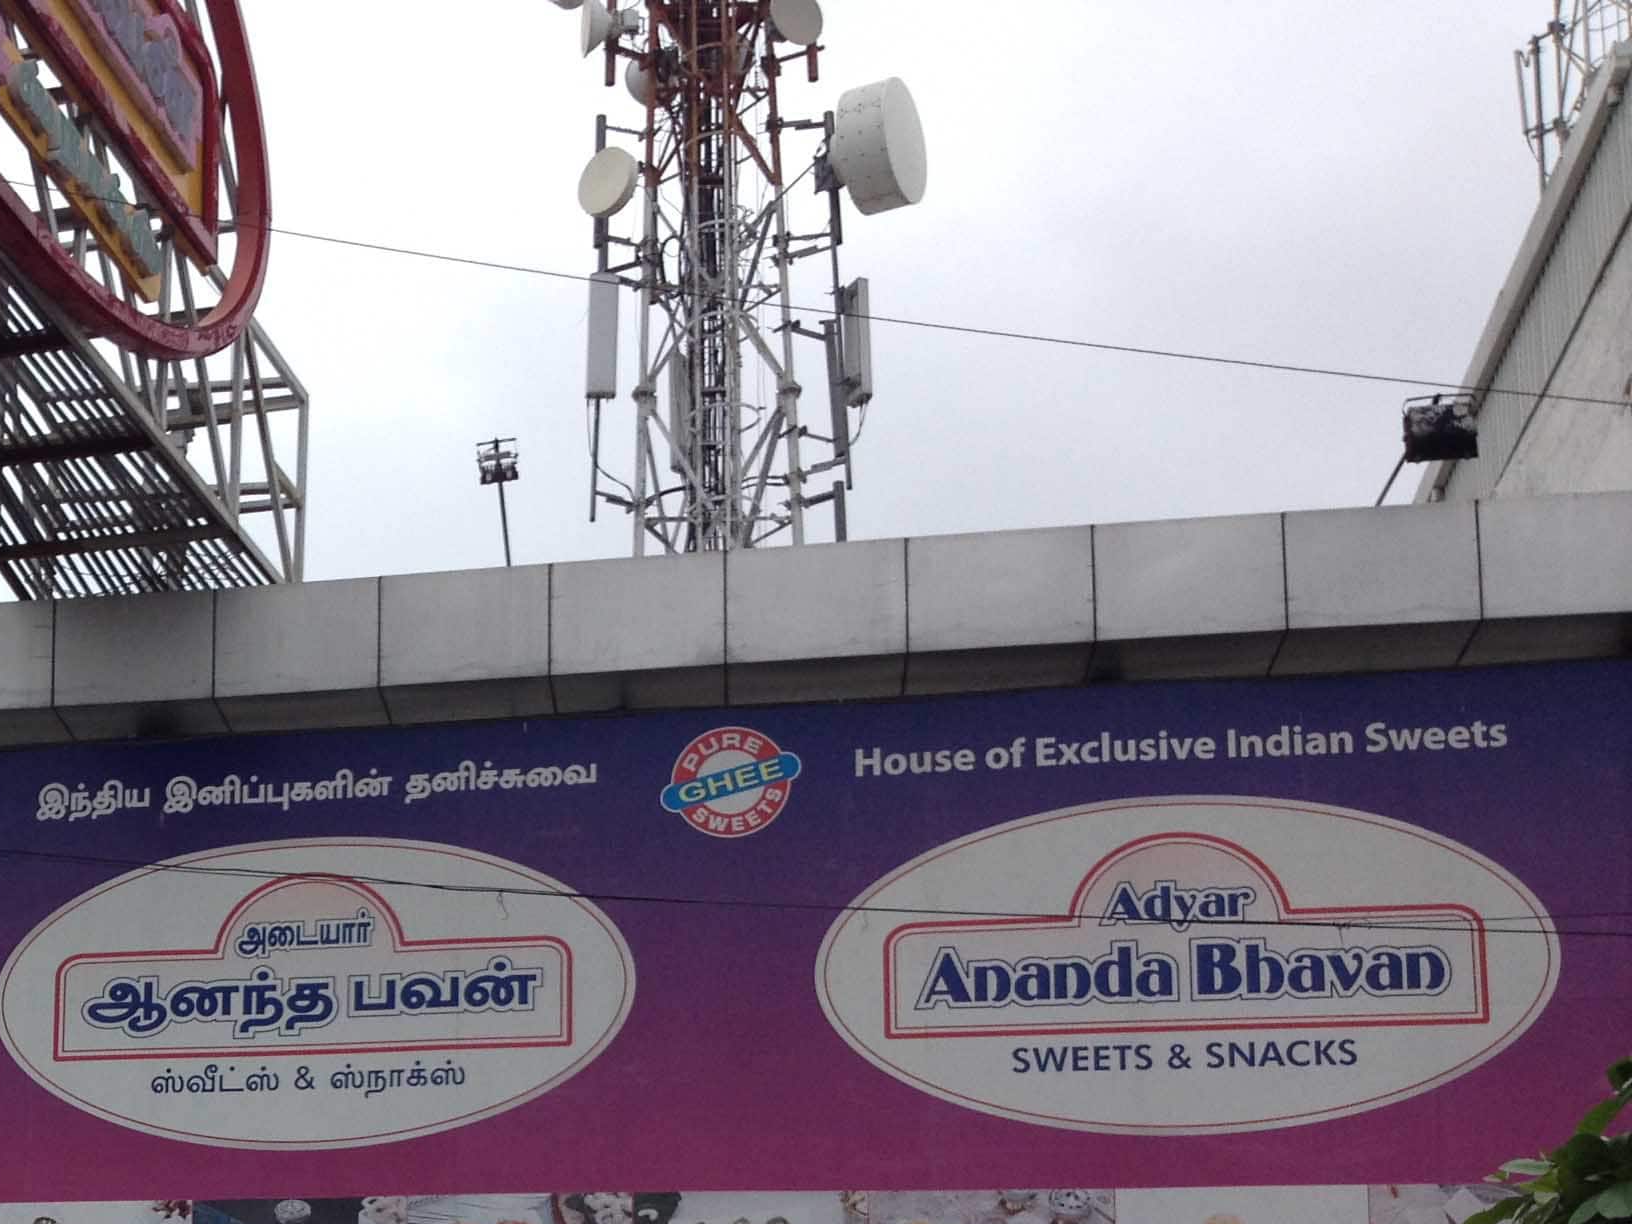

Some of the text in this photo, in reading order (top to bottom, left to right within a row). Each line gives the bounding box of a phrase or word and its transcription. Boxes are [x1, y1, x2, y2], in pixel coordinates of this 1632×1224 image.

[682, 732, 764, 773] PURE
[855, 718, 1509, 777] House of Exclusive Indian Sweets
[36, 758, 598, 822] இந்திய இனிப்புகளின் தனிச்சுவை
[678, 758, 785, 803] GHEE
[691, 787, 783, 833] SWEETS
[1107, 884, 1255, 931] Adyar
[237, 908, 373, 957] அடையார்
[921, 940, 1452, 1005] Ananda Bhavan
[86, 960, 537, 1034] ஆனந்த பவன்
[150, 1057, 467, 1099] ஸ்வீட்ஸ் & ஸ்நாக்ஸ்
[1011, 1038, 1359, 1074] SWEETS & SNACKS
